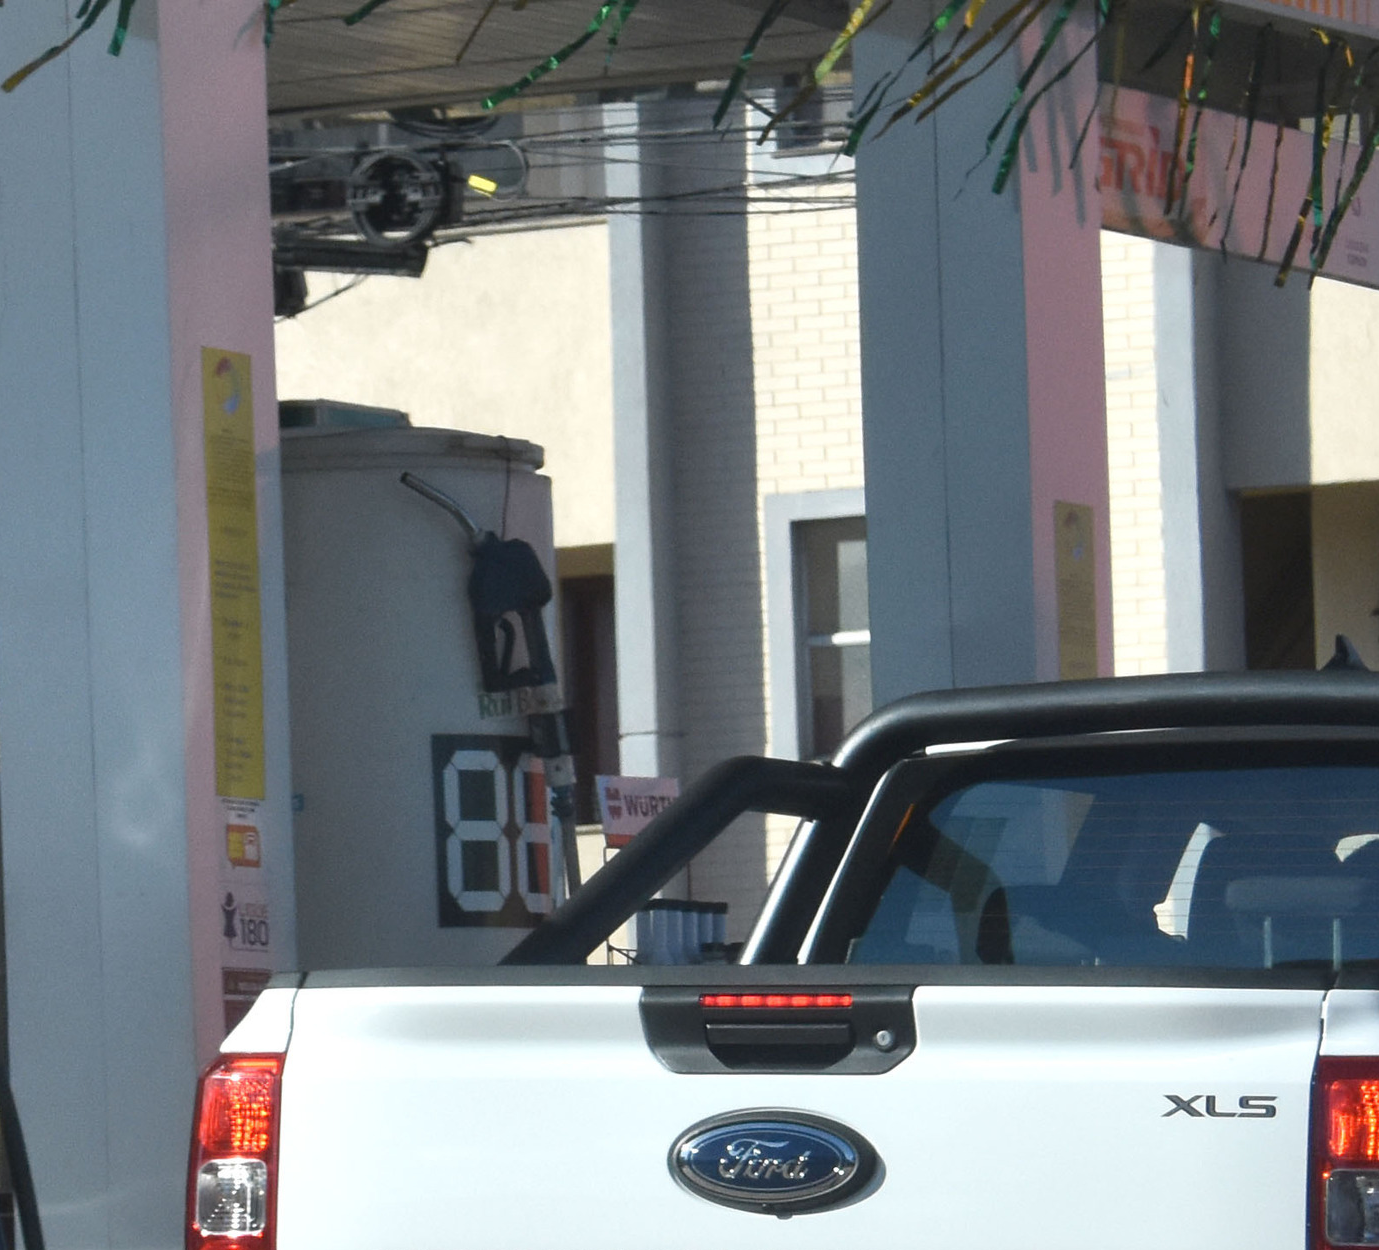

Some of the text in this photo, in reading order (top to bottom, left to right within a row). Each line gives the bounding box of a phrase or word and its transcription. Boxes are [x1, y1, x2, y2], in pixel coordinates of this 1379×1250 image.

[240, 918, 269, 947] 180
[1161, 1094, 1278, 1119] XLS
[719, 1139, 811, 1181] Ford
